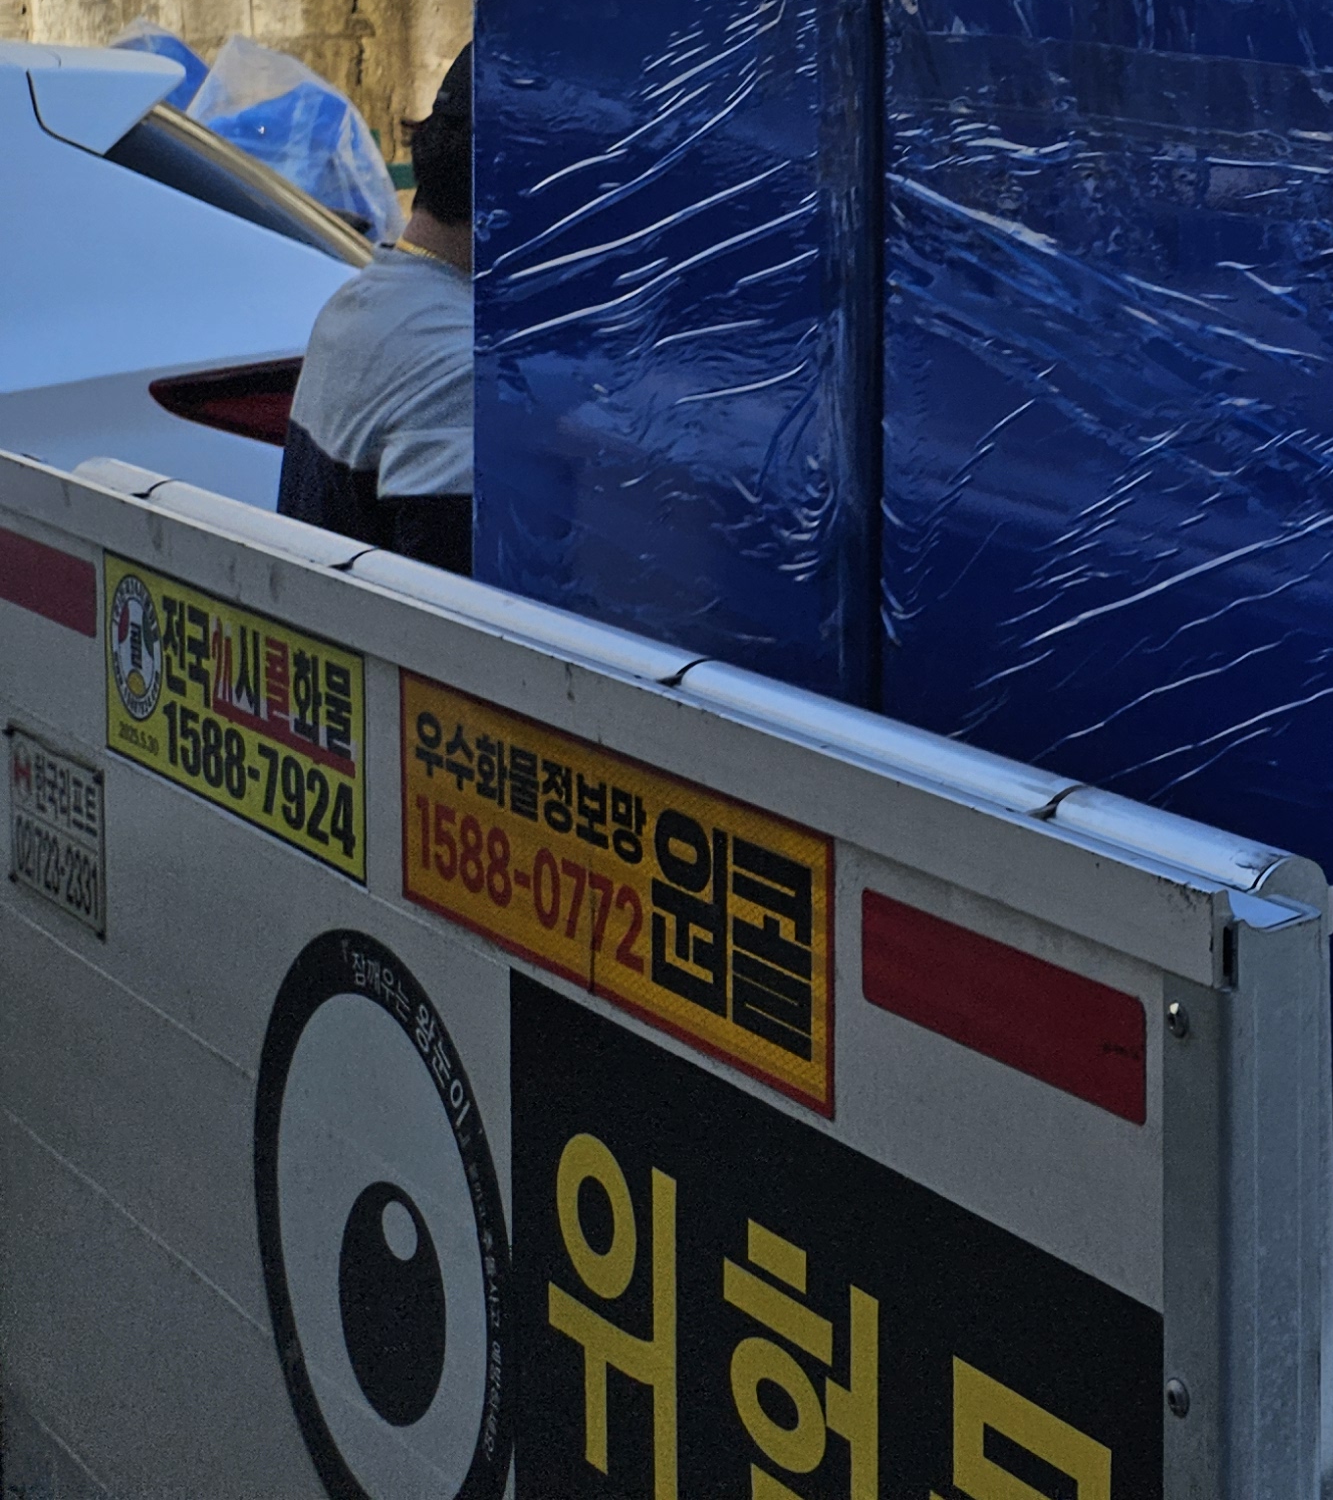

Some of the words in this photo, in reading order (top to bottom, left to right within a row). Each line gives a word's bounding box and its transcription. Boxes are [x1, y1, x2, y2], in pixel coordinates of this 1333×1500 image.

[162, 700, 356, 860] 1588-7924
[415, 711, 648, 865] 우수화물정보망
[414, 794, 645, 976] 1588-0772
[651, 807, 813, 1063] 원콜
